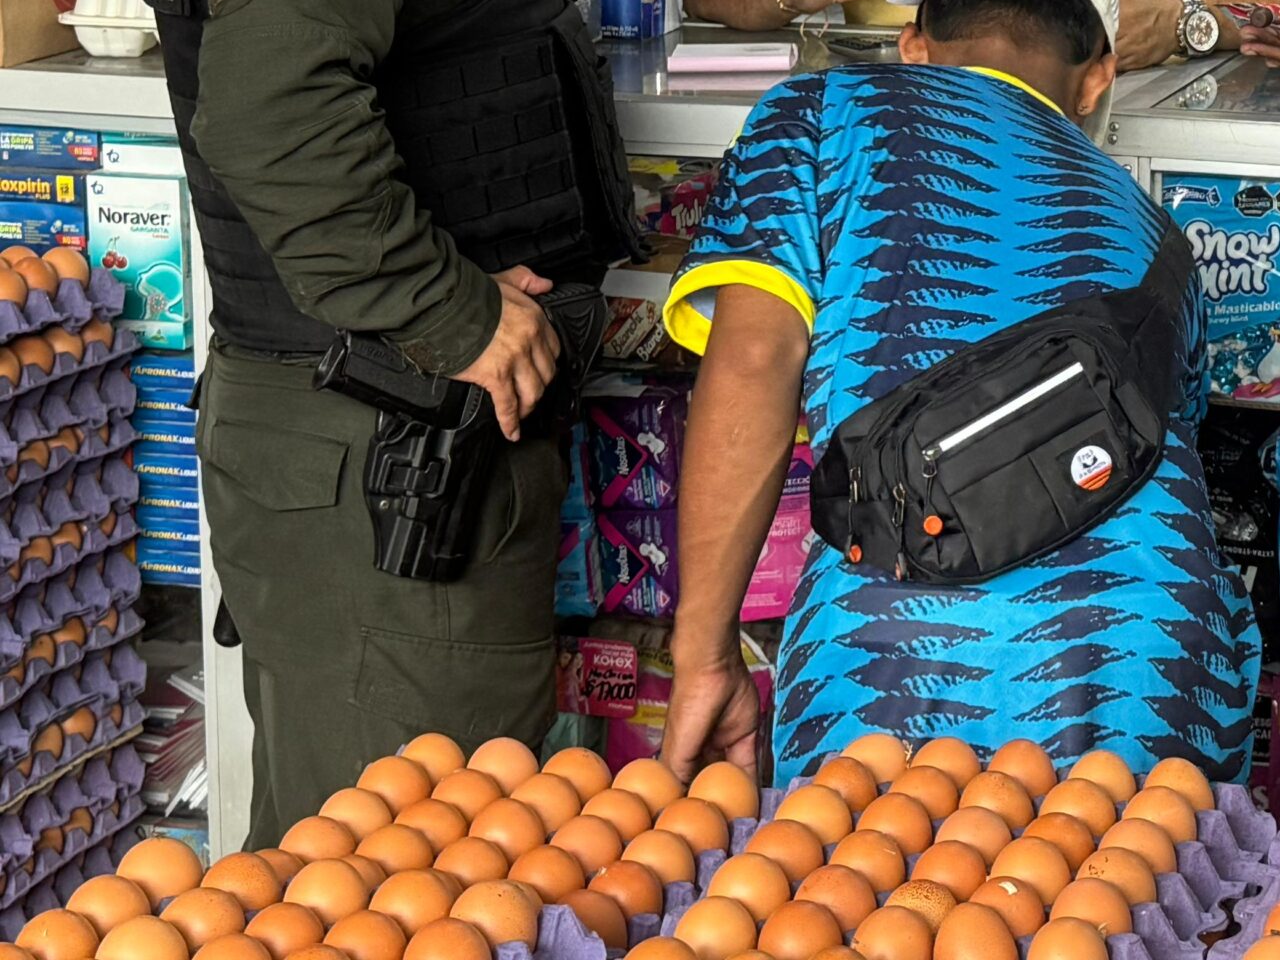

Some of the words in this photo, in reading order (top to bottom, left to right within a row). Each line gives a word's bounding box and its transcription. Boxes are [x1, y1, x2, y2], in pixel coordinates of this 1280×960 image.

[0, 177, 51, 195] oxpirin
[98, 207, 168, 227] Noraver
[130, 226, 170, 234] GARGANTA
